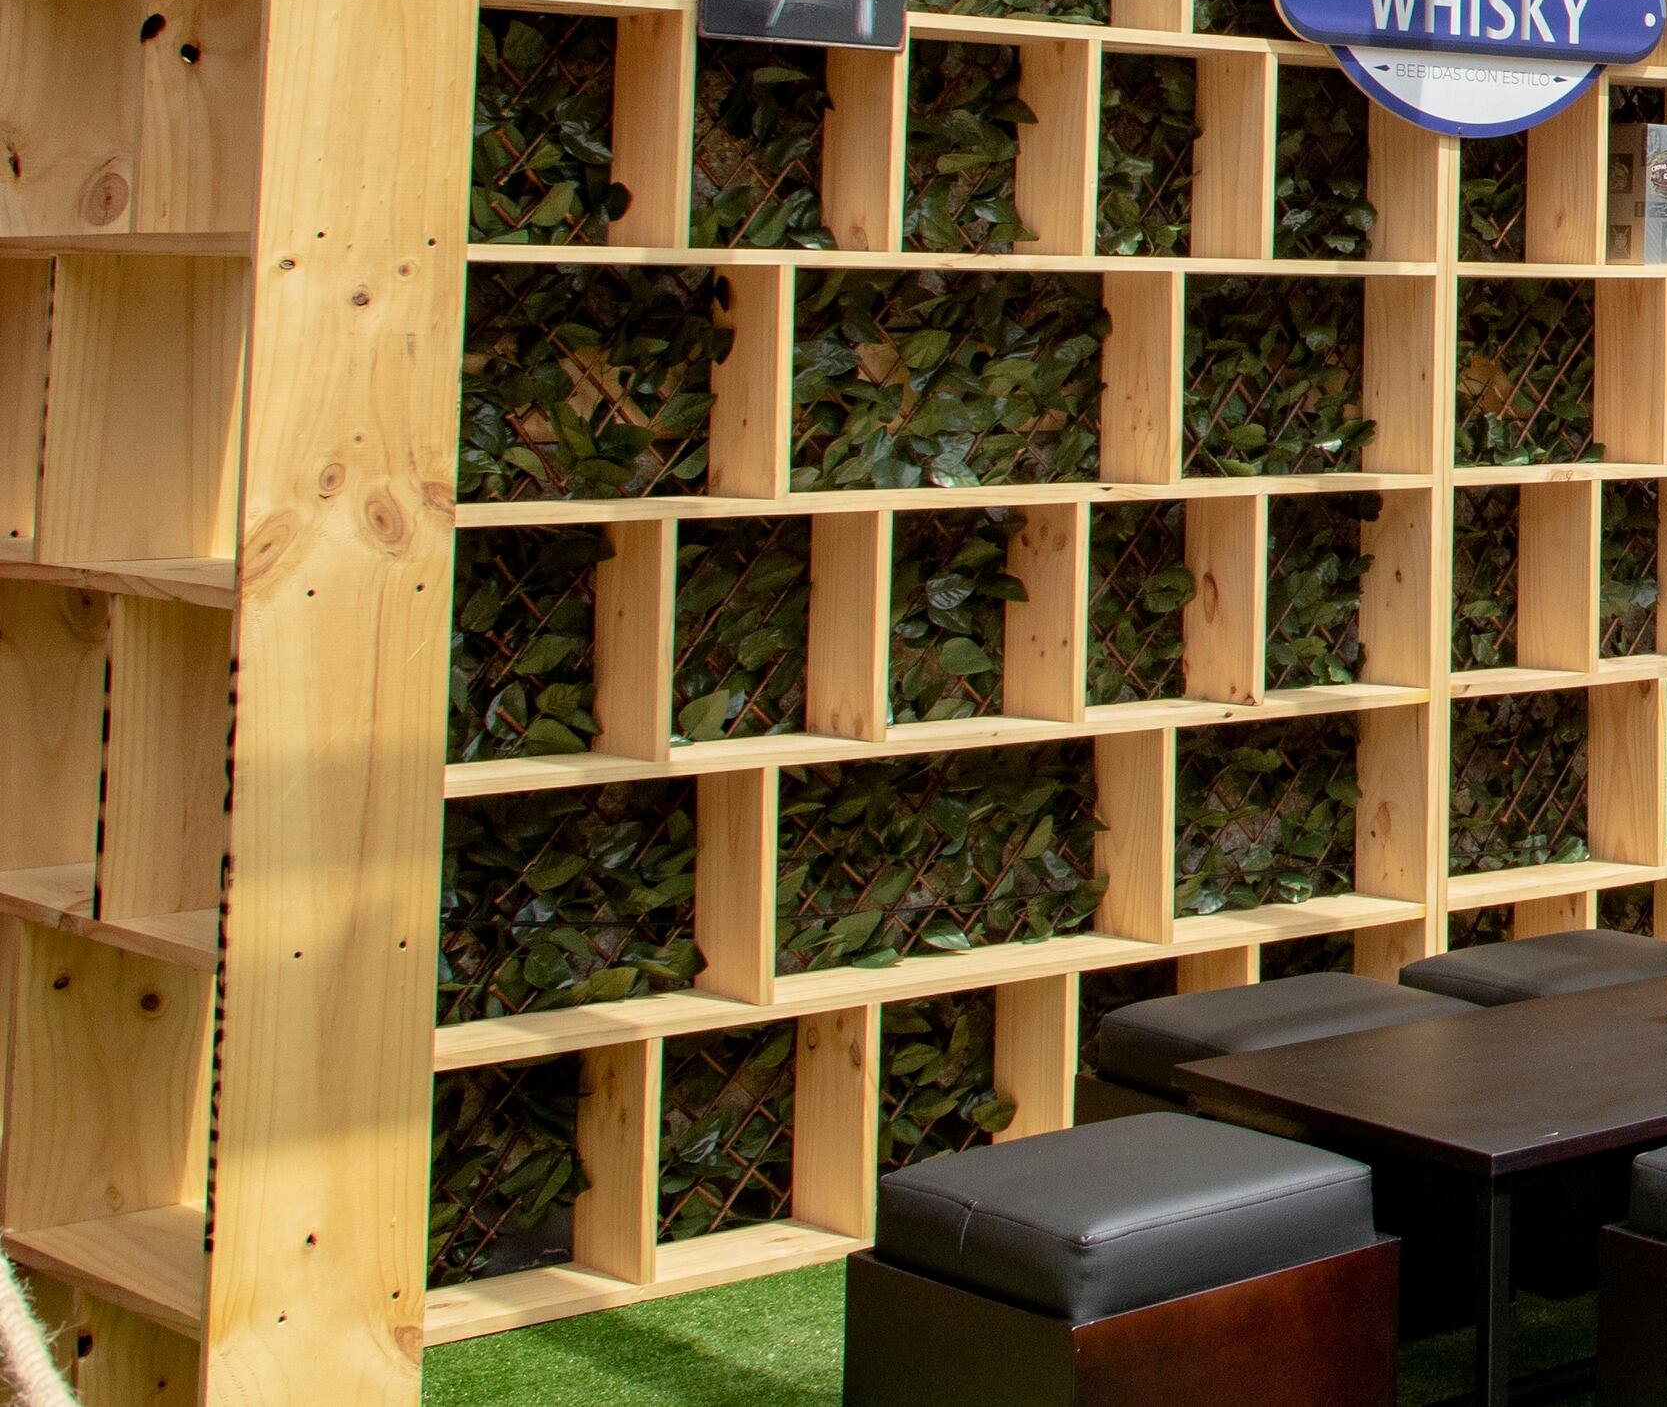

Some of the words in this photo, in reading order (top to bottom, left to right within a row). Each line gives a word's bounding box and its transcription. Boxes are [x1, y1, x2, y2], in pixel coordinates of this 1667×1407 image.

[1396, 63, 1462, 81] BEBIDAS
[1465, 67, 1498, 84] CON
[1502, 70, 1550, 87] ESTILO
